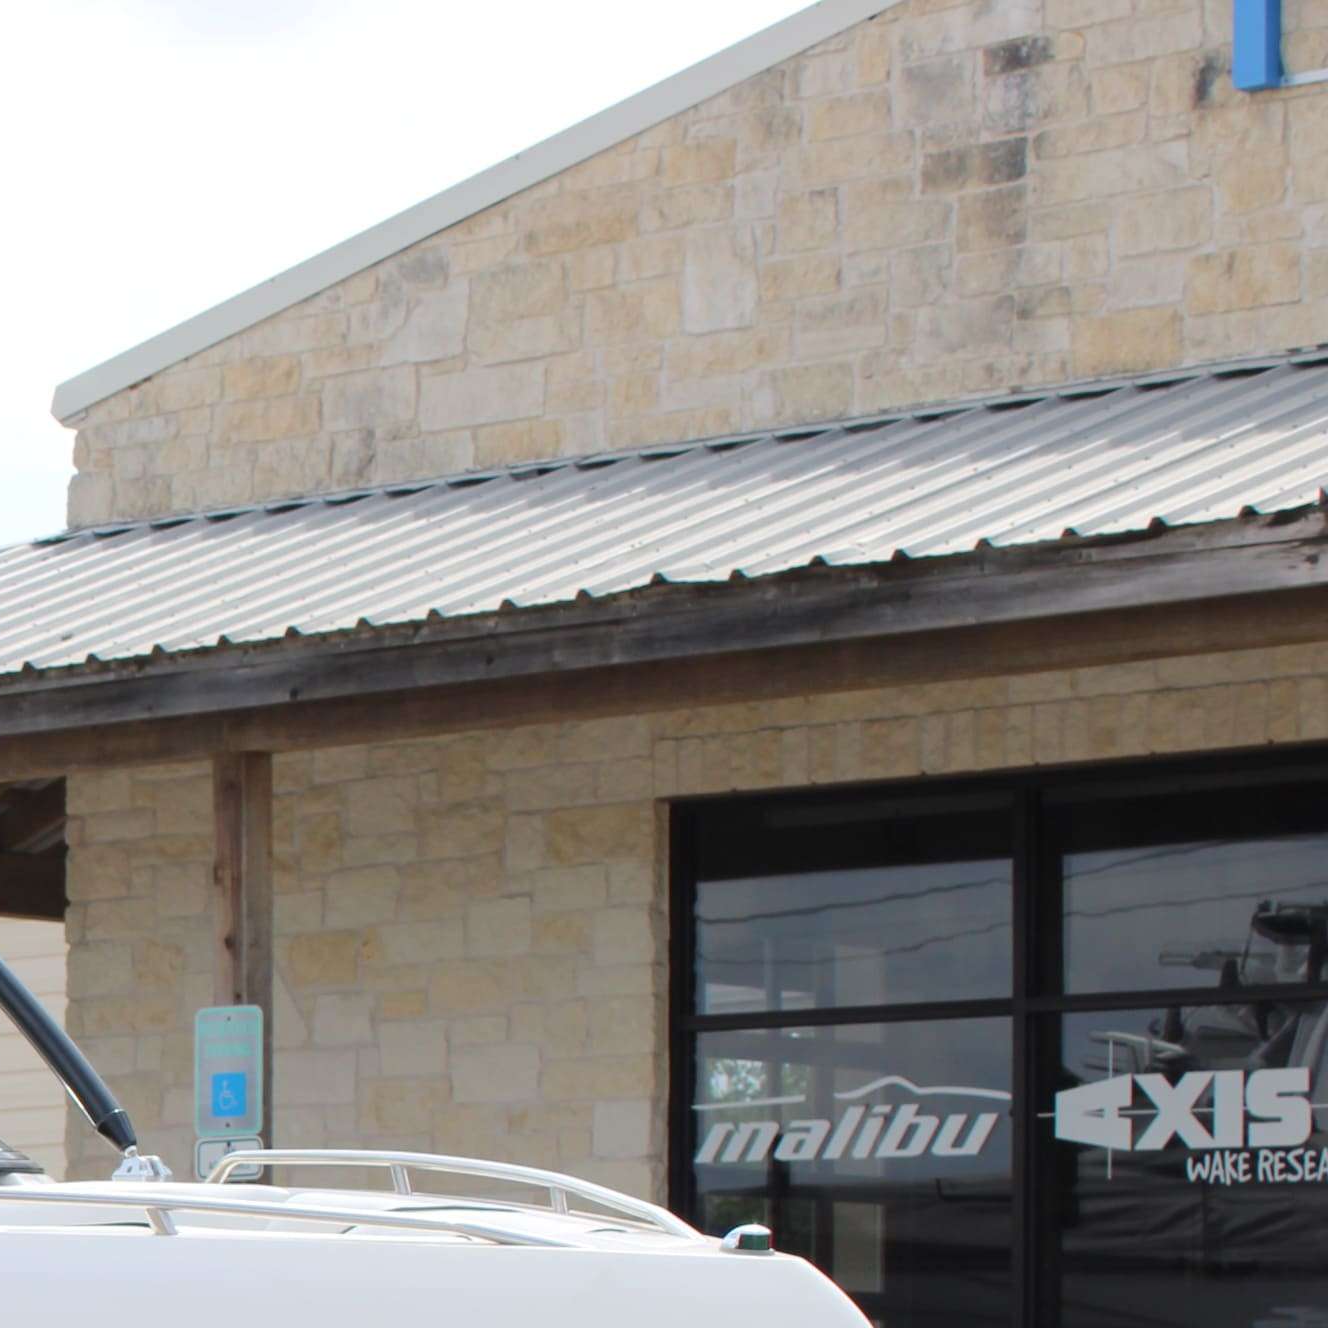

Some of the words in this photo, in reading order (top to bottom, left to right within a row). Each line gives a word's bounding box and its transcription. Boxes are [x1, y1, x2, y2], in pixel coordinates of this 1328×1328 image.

[694, 1103, 999, 1164] malibu
[1055, 1067, 1312, 1151] AXIS
[1187, 1152, 1252, 1186] WAKE
